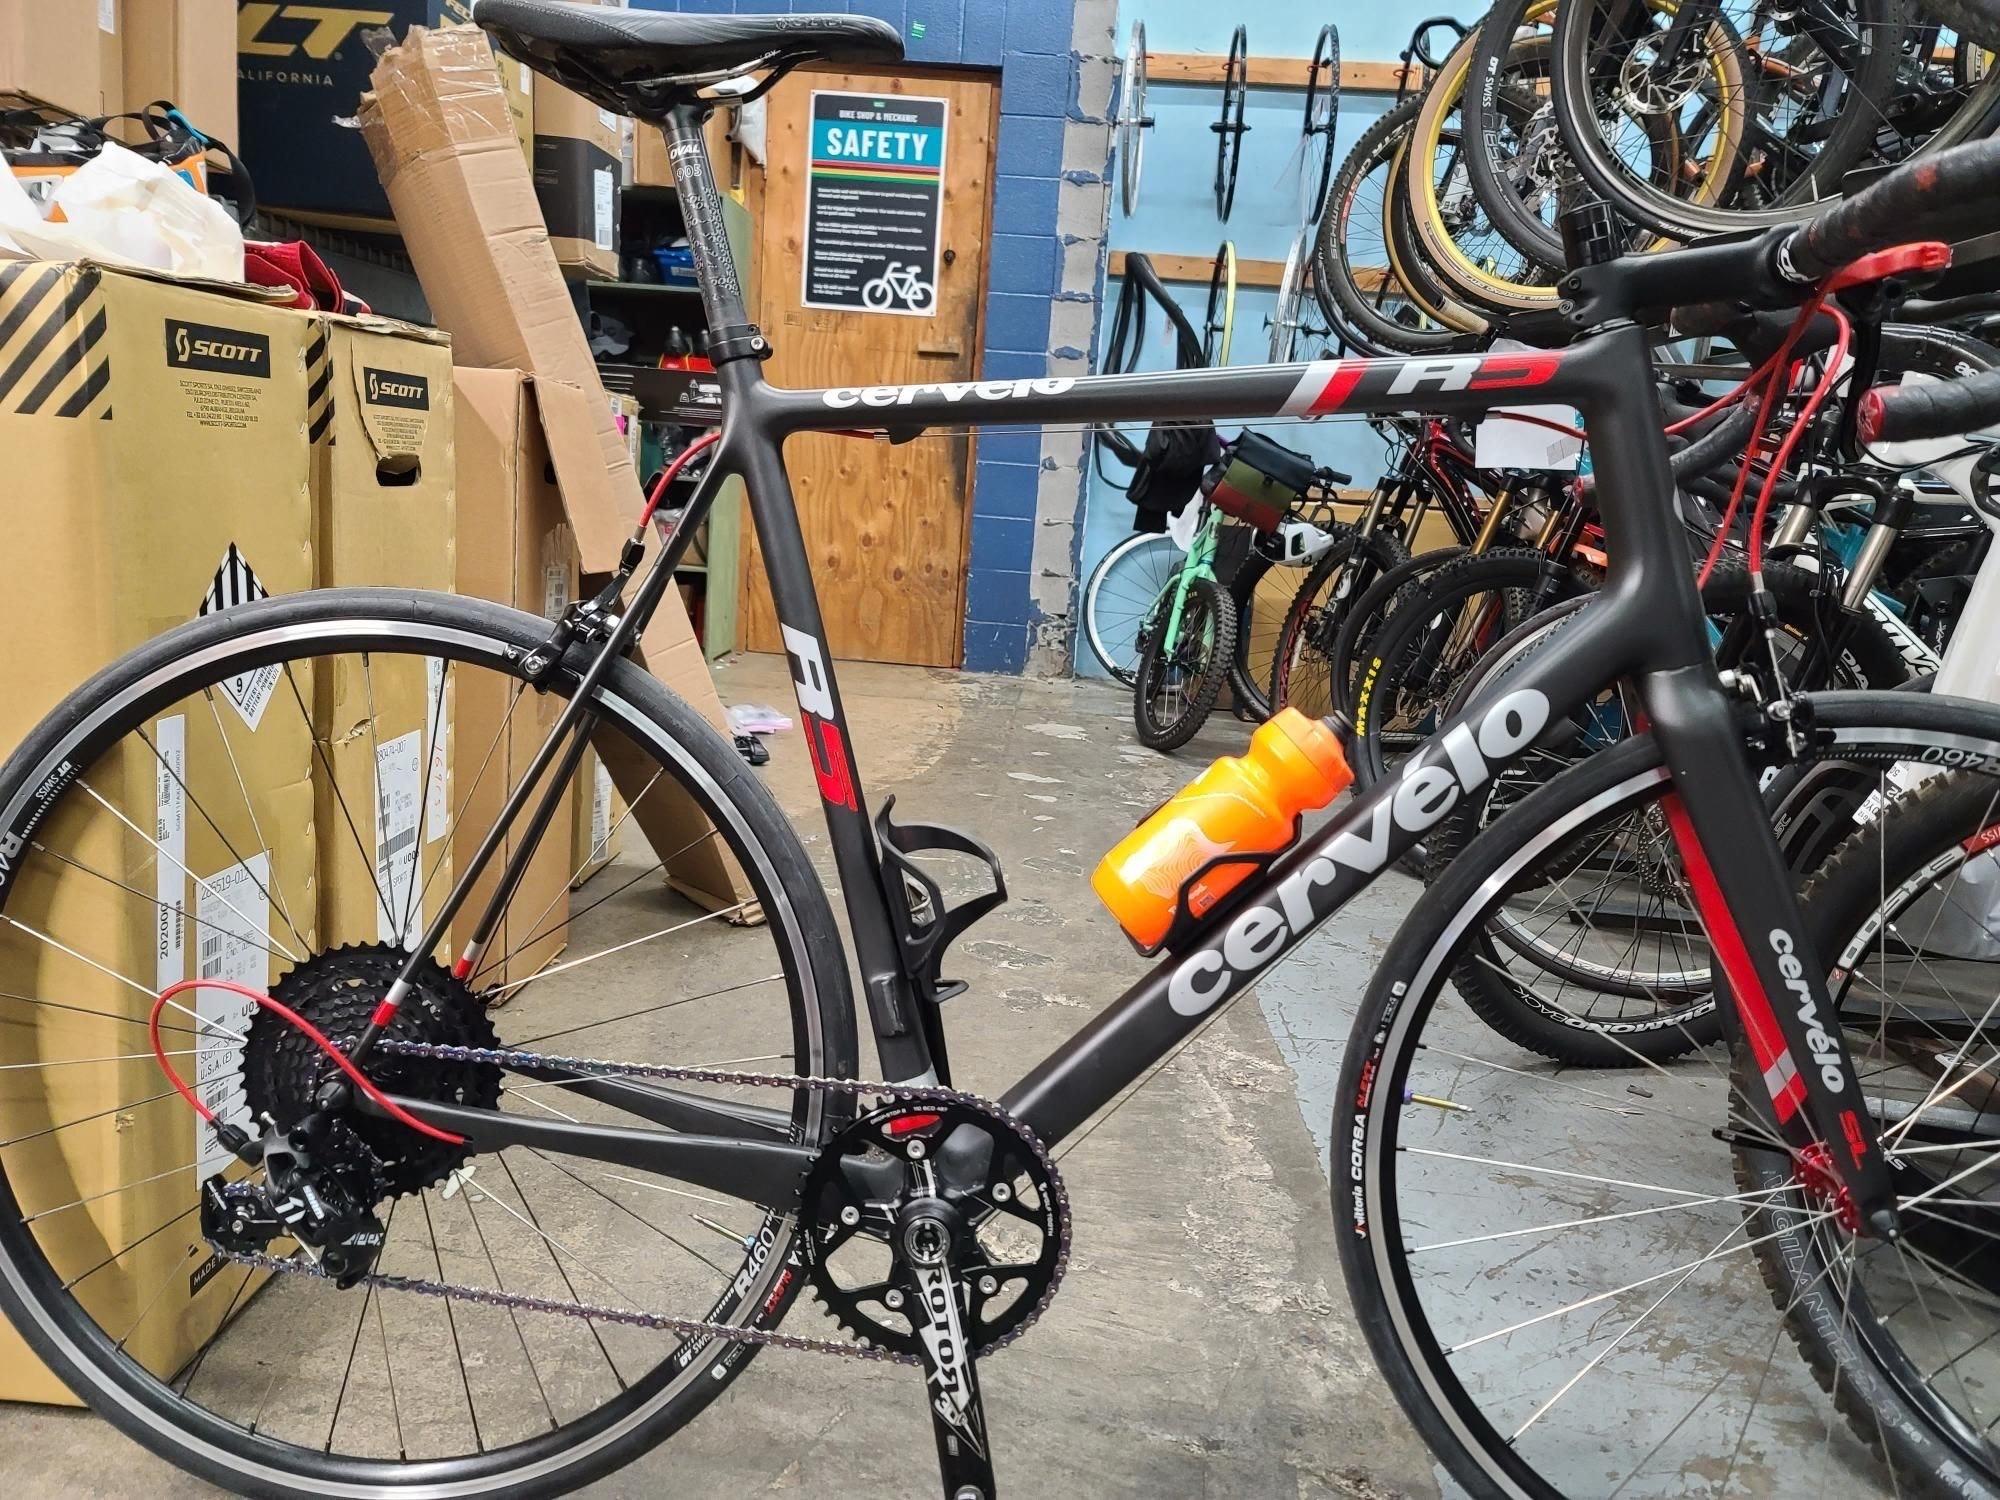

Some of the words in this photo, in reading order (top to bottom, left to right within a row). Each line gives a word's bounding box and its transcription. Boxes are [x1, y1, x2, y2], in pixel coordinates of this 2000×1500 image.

[1489, 55, 1499, 75] DT
[1482, 75, 1495, 107] SWISS
[857, 111, 875, 120] SHOP
[670, 143, 701, 160] OVAL
[826, 127, 928, 161] SAFETY
[677, 162, 703, 182] 905
[191, 339, 263, 363] SCOTT
[379, 382, 424, 399] SCOTT
[236, 677, 243, 693] 9
[1356, 655, 1383, 738] MAXXIS
[57, 760, 72, 777] DT
[35, 774, 59, 800] SWISS
[1168, 688, 1550, 1017] cervélo
[1768, 928, 1845, 1093] cervélo
[1350, 1113, 1367, 1183] CORSA
[193, 1258, 217, 1287] MADE
[733, 1227, 777, 1300] R460
[1761, 1173, 1858, 1366] VIGILANTE
[926, 1266, 961, 1395] ROTOR
[679, 1349, 693, 1368] DT
